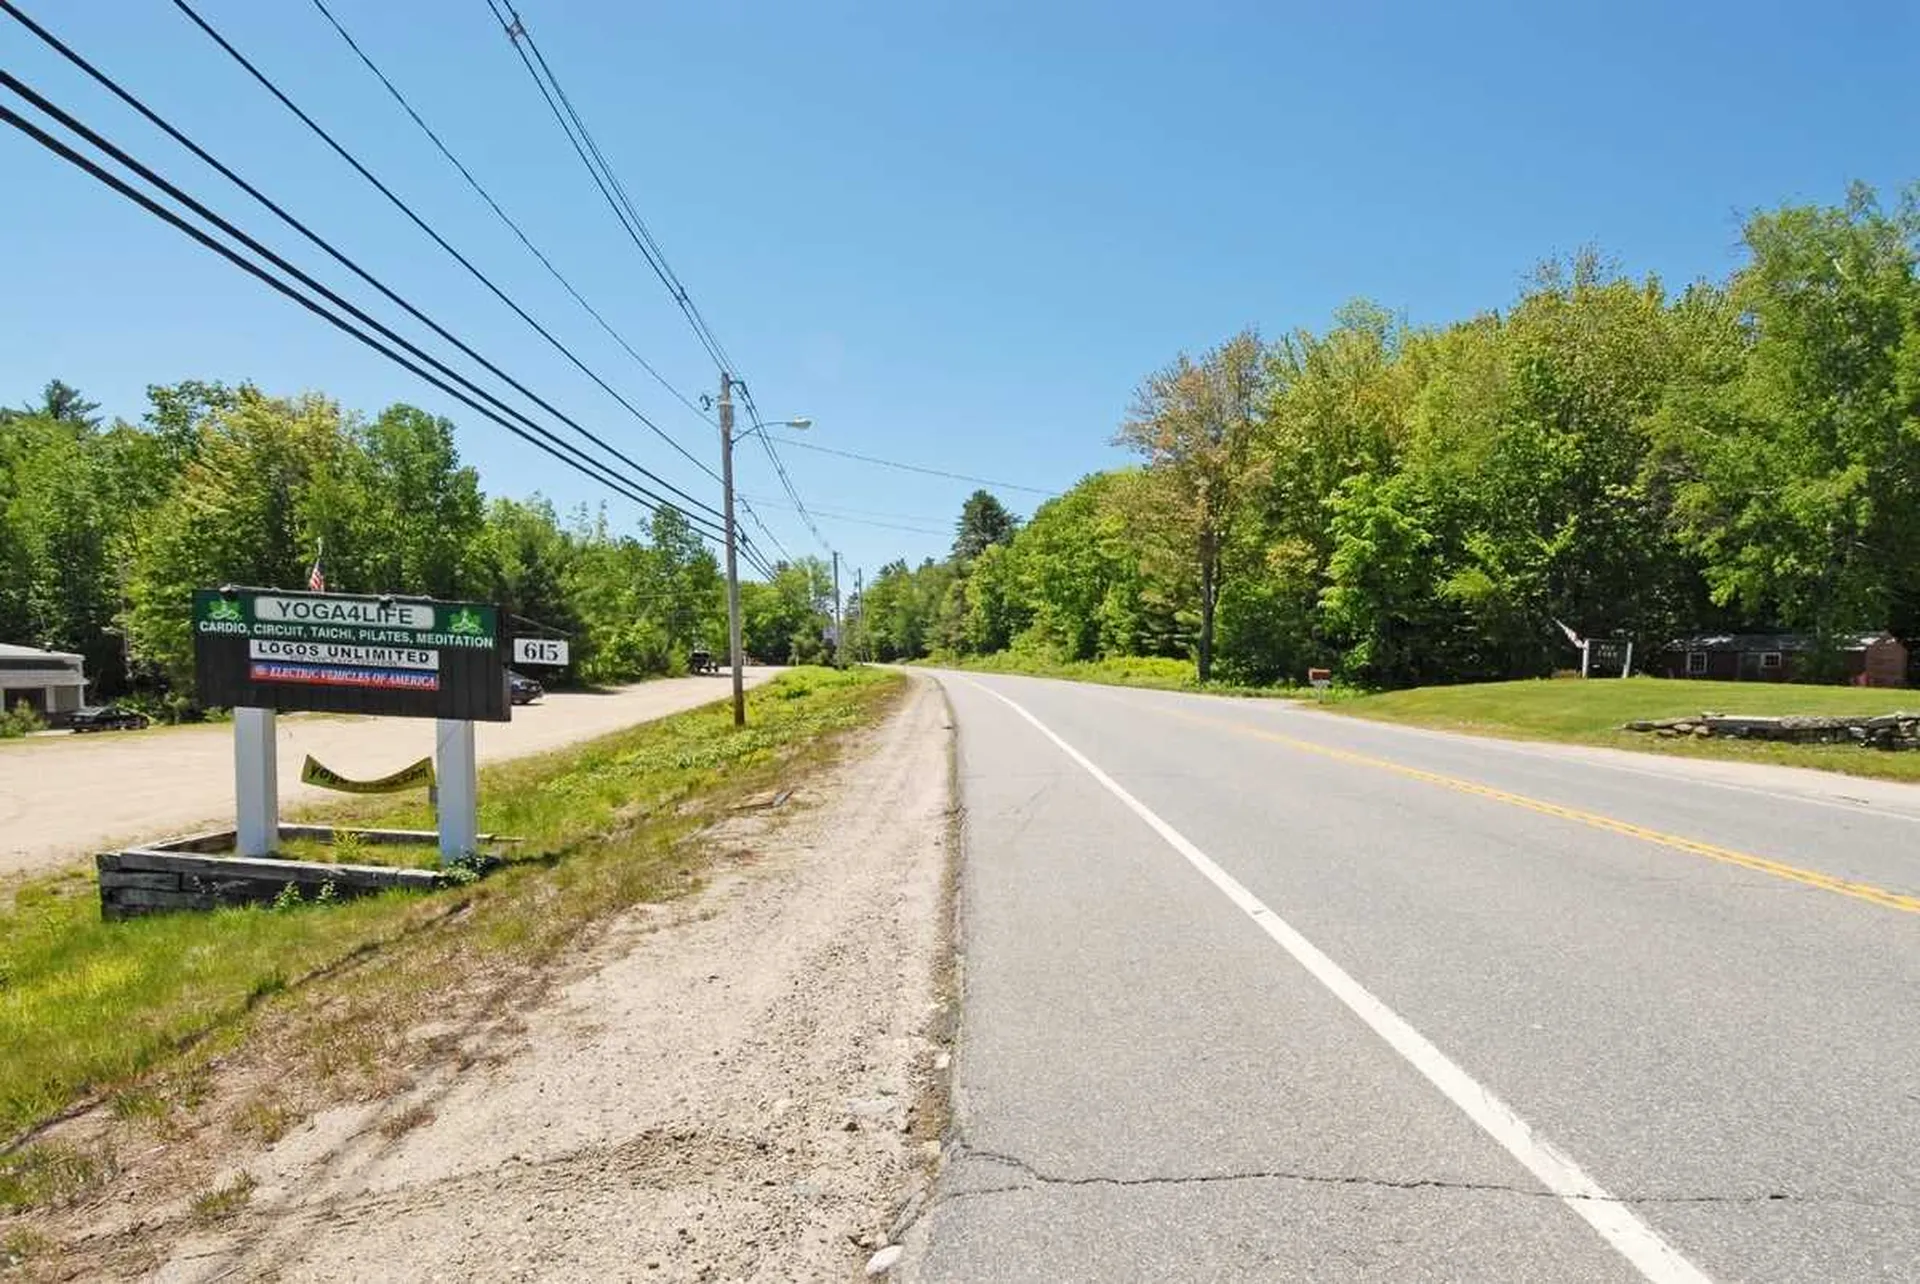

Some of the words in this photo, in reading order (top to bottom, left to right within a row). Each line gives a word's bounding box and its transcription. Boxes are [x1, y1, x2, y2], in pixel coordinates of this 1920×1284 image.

[277, 601, 413, 625] YOGA4LIFE
[199, 620, 250, 636] CARDIO,
[253, 624, 308, 638] CIRCUIT,
[311, 627, 356, 641] TAICHI,
[359, 629, 414, 644] PILATES,
[416, 633, 494, 649] MEDITATION
[258, 643, 320, 656] LOGOS
[327, 646, 430, 663] UNLIMITED
[524, 642, 559, 661] 615
[269, 665, 320, 679] ELECTRIC
[372, 672, 387, 685] OF
[387, 673, 435, 687] AMERICA
